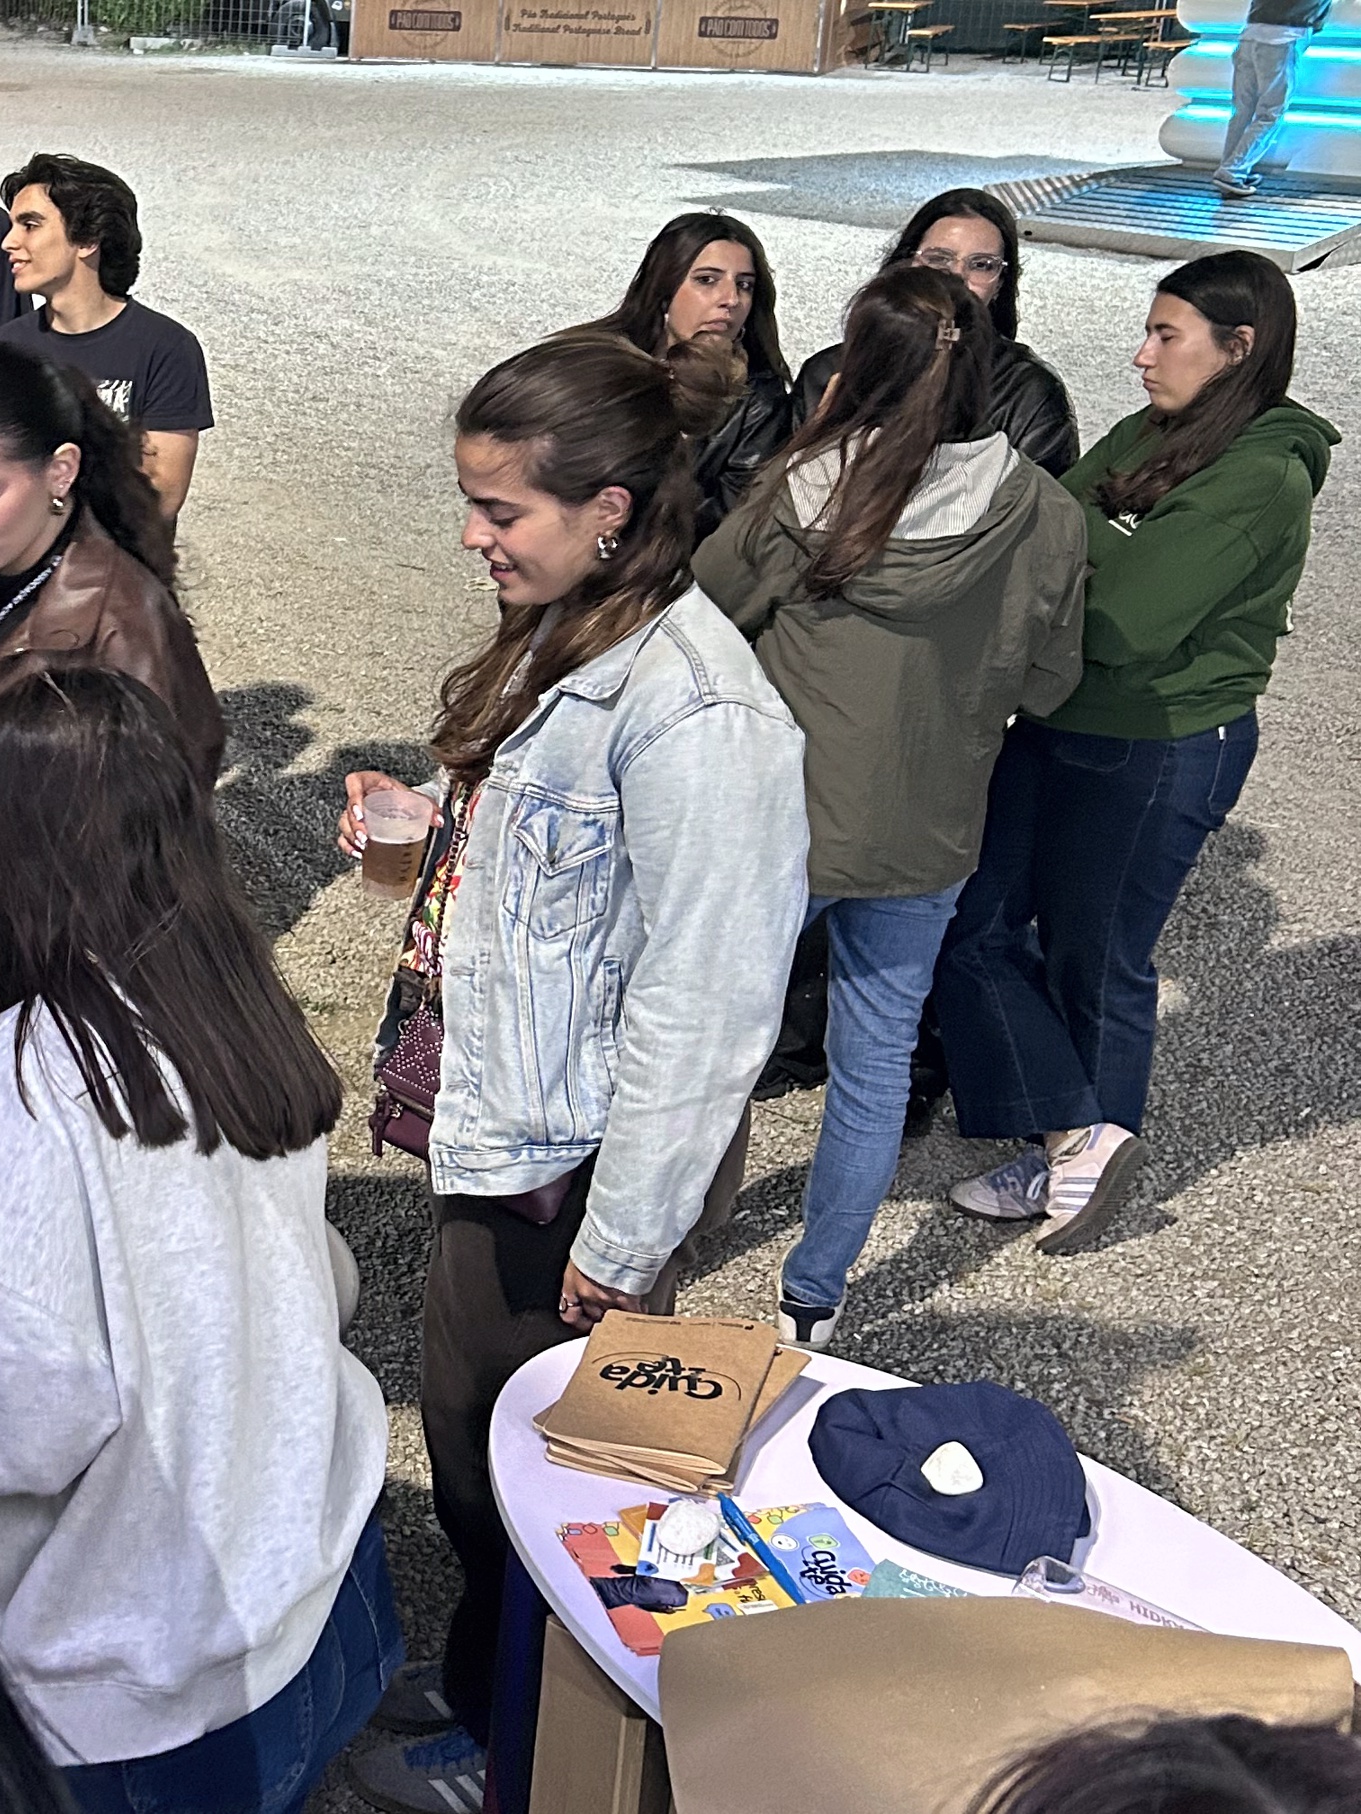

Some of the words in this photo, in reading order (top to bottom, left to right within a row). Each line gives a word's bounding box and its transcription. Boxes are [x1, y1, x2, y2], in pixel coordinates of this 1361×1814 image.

[540, 9, 590, 20] Tradicional
[512, 24, 561, 33] Traditional
[562, 25, 611, 37] Portuguese
[599, 1362, 723, 1400] Cuida
[811, 1550, 853, 1596] Cuida
